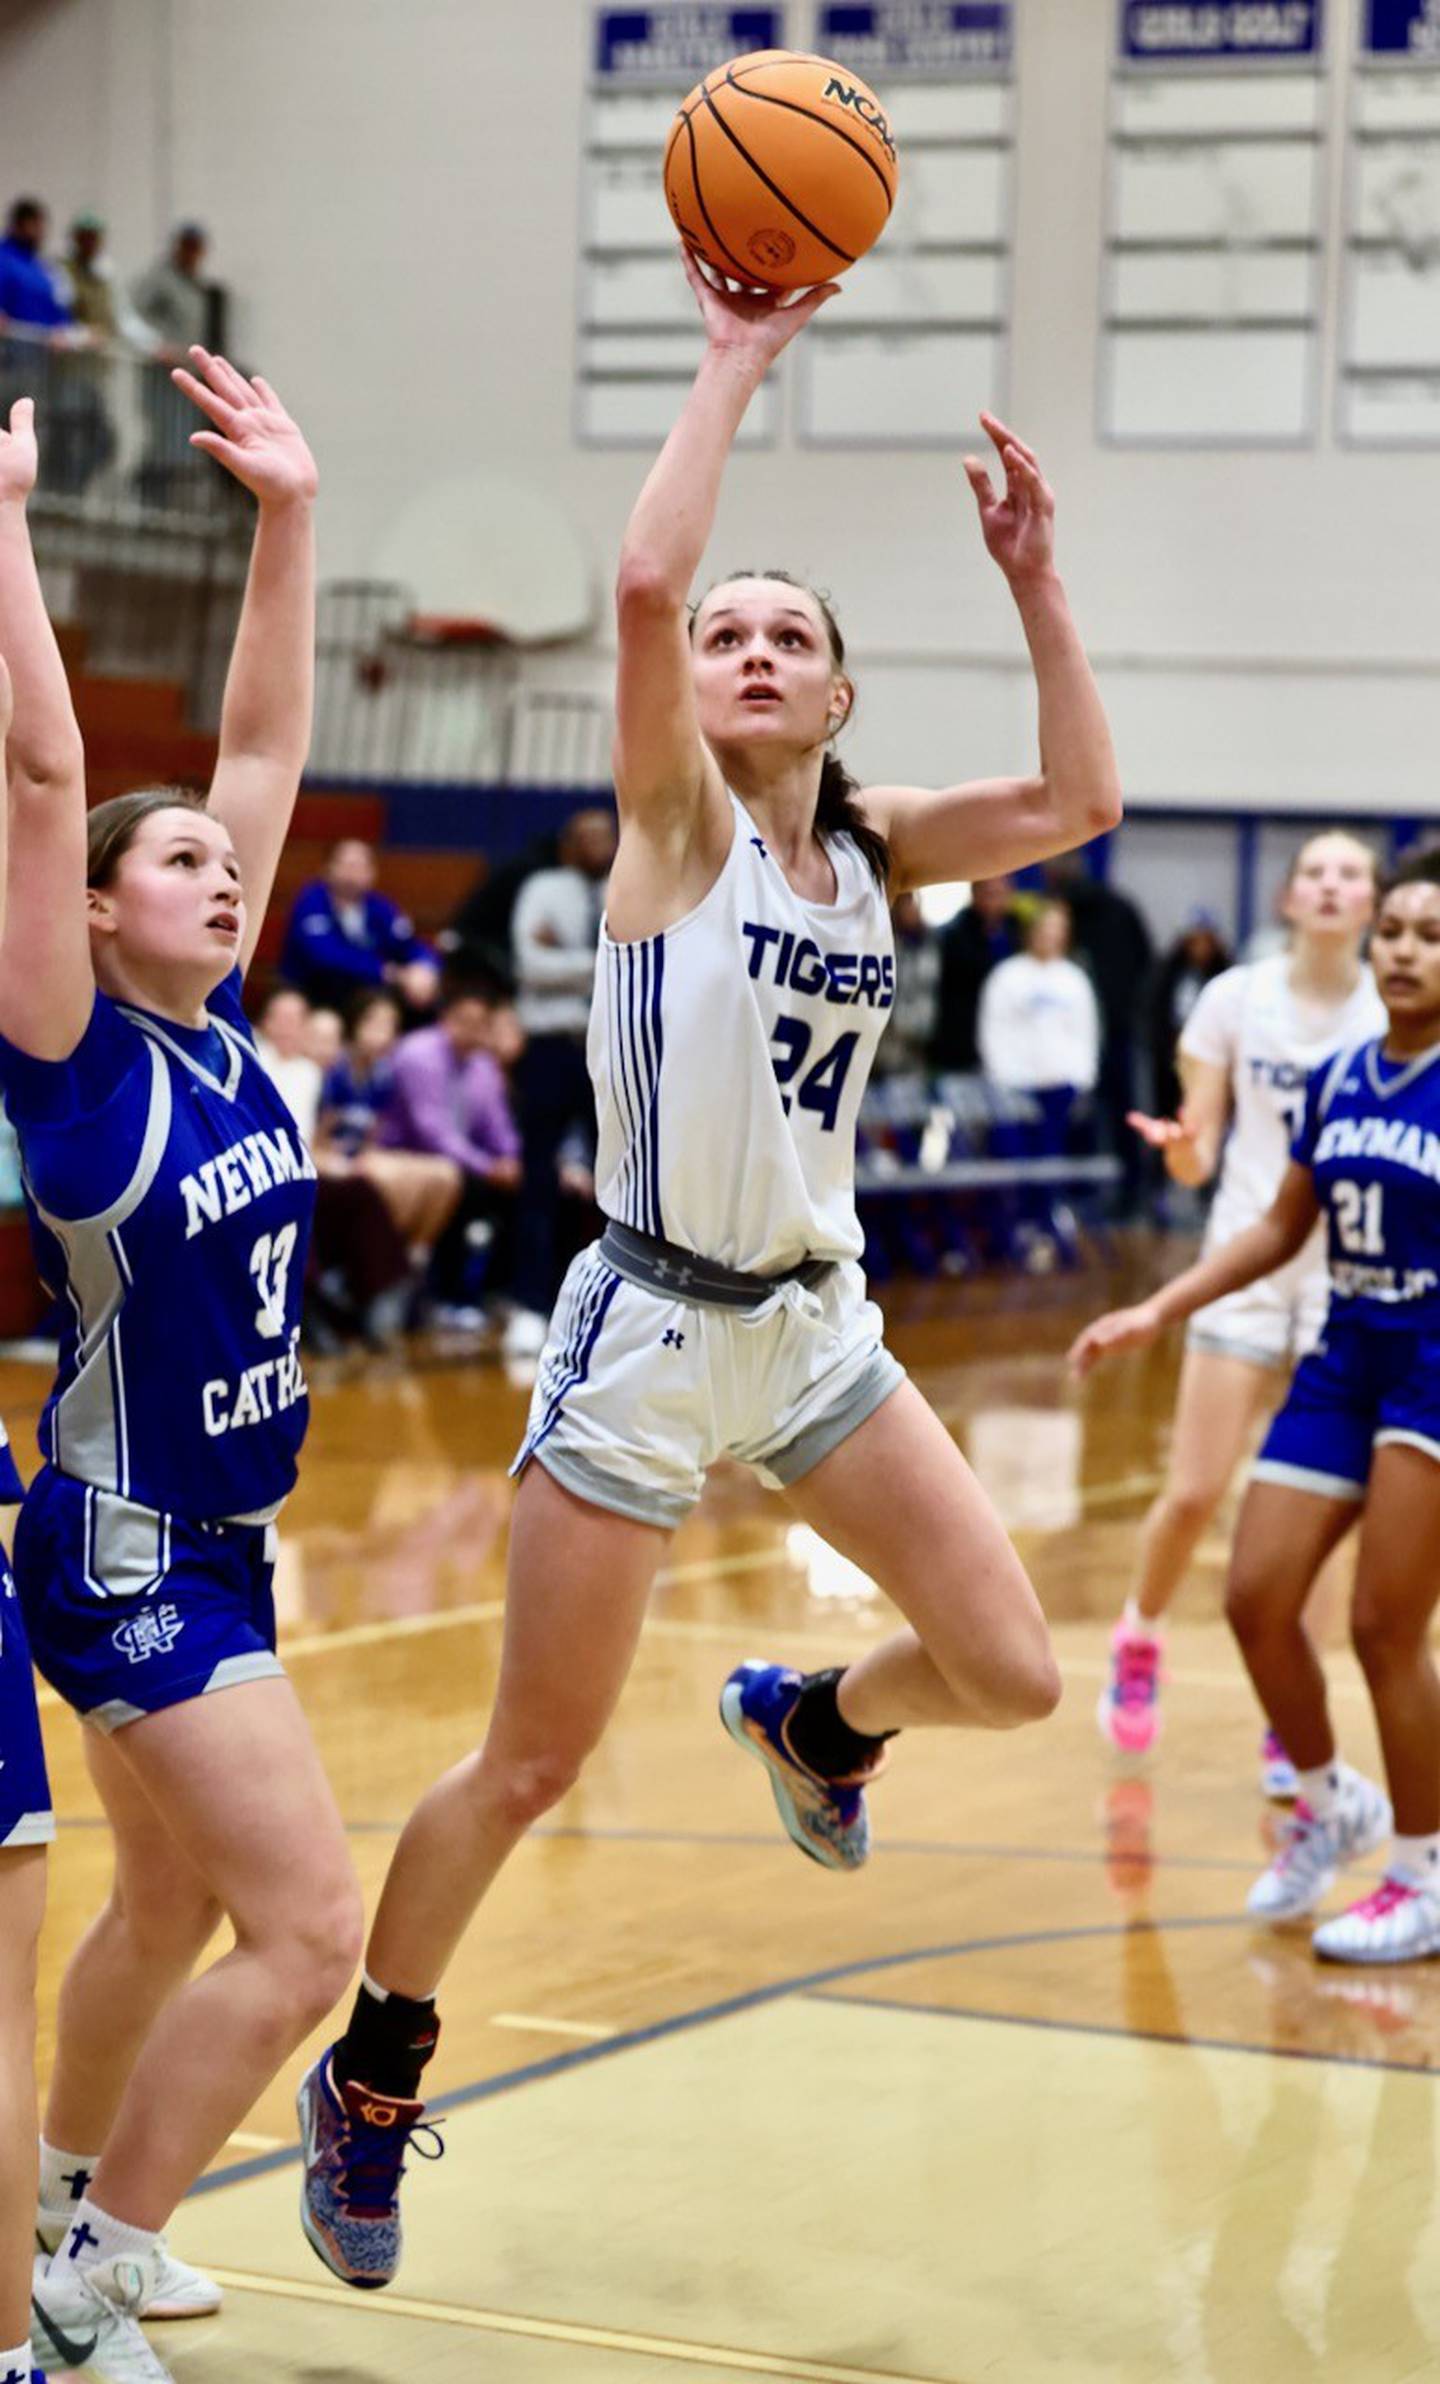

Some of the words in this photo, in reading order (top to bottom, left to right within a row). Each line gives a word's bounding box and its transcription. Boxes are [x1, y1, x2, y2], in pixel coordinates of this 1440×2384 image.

[742, 921, 893, 1009] TIGERS
[770, 1013, 862, 1133] 24
[1331, 1179, 1385, 1256] 21
